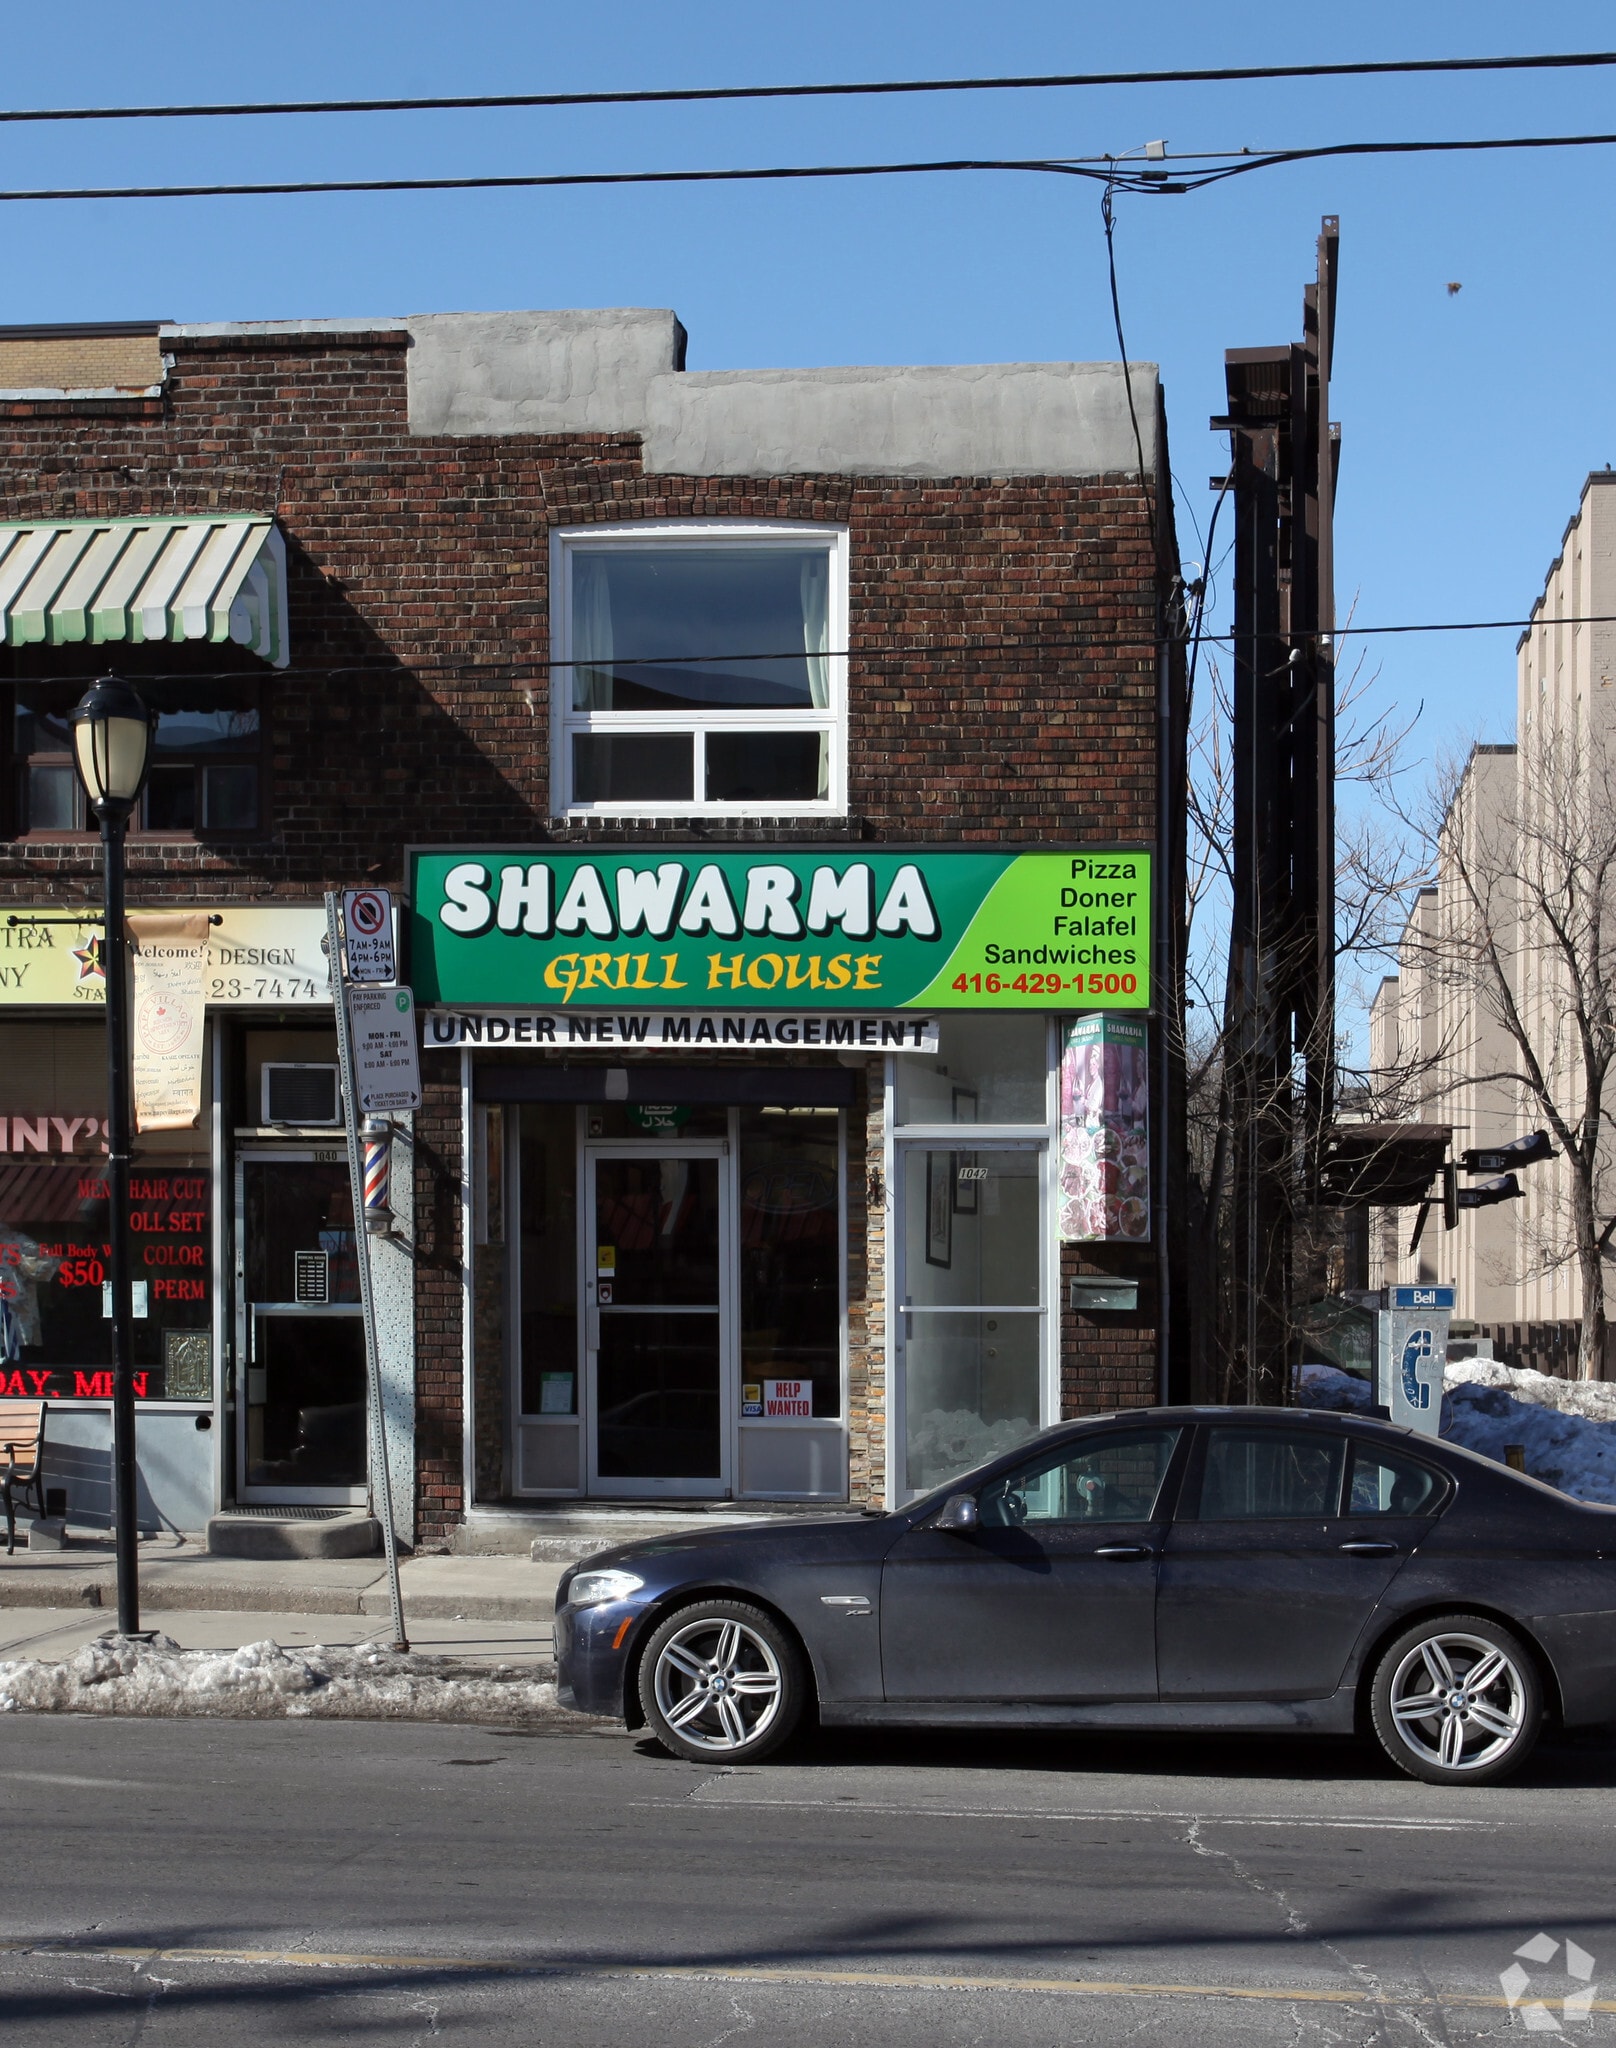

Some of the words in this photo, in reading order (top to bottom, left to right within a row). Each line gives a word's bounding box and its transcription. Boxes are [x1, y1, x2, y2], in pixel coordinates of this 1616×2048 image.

[1071, 859, 1137, 880] Pizza
[439, 861, 942, 942] SHAWARMA
[1060, 887, 1137, 908] Doner
[1054, 916, 1137, 936] Falafel
[132, 945, 203, 958] Welcome!
[220, 949, 295, 965] DESIGN
[985, 944, 1137, 964] Sandwiches
[205, 979, 317, 998] 23-7474
[543, 953, 688, 1005] GRILL
[707, 953, 883, 991] HOUSE
[952, 973, 1137, 995] 416-429-1500
[73, 985, 106, 1000] STA
[432, 1015, 558, 1046] UNDER
[568, 1015, 652, 1047] NEW
[660, 1016, 930, 1049] MANAGEMENT
[380, 1050, 392, 1058] SAT
[0, 1117, 110, 1153] NY'
[313, 1151, 338, 1161] 1040
[961, 1168, 986, 1179] 1042
[130, 1179, 169, 1199] HAIR
[172, 1179, 205, 1199] CUT
[169, 1211, 205, 1232] SET
[39, 1243, 62, 1258] Full
[67, 1243, 98, 1259] Body
[143, 1245, 205, 1266] COLOR
[59, 1260, 105, 1287] $50
[153, 1279, 206, 1300] PERM
[1413, 1290, 1436, 1304] Bell
[775, 1382, 801, 1398] HELP
[766, 1400, 810, 1416] WANTED
